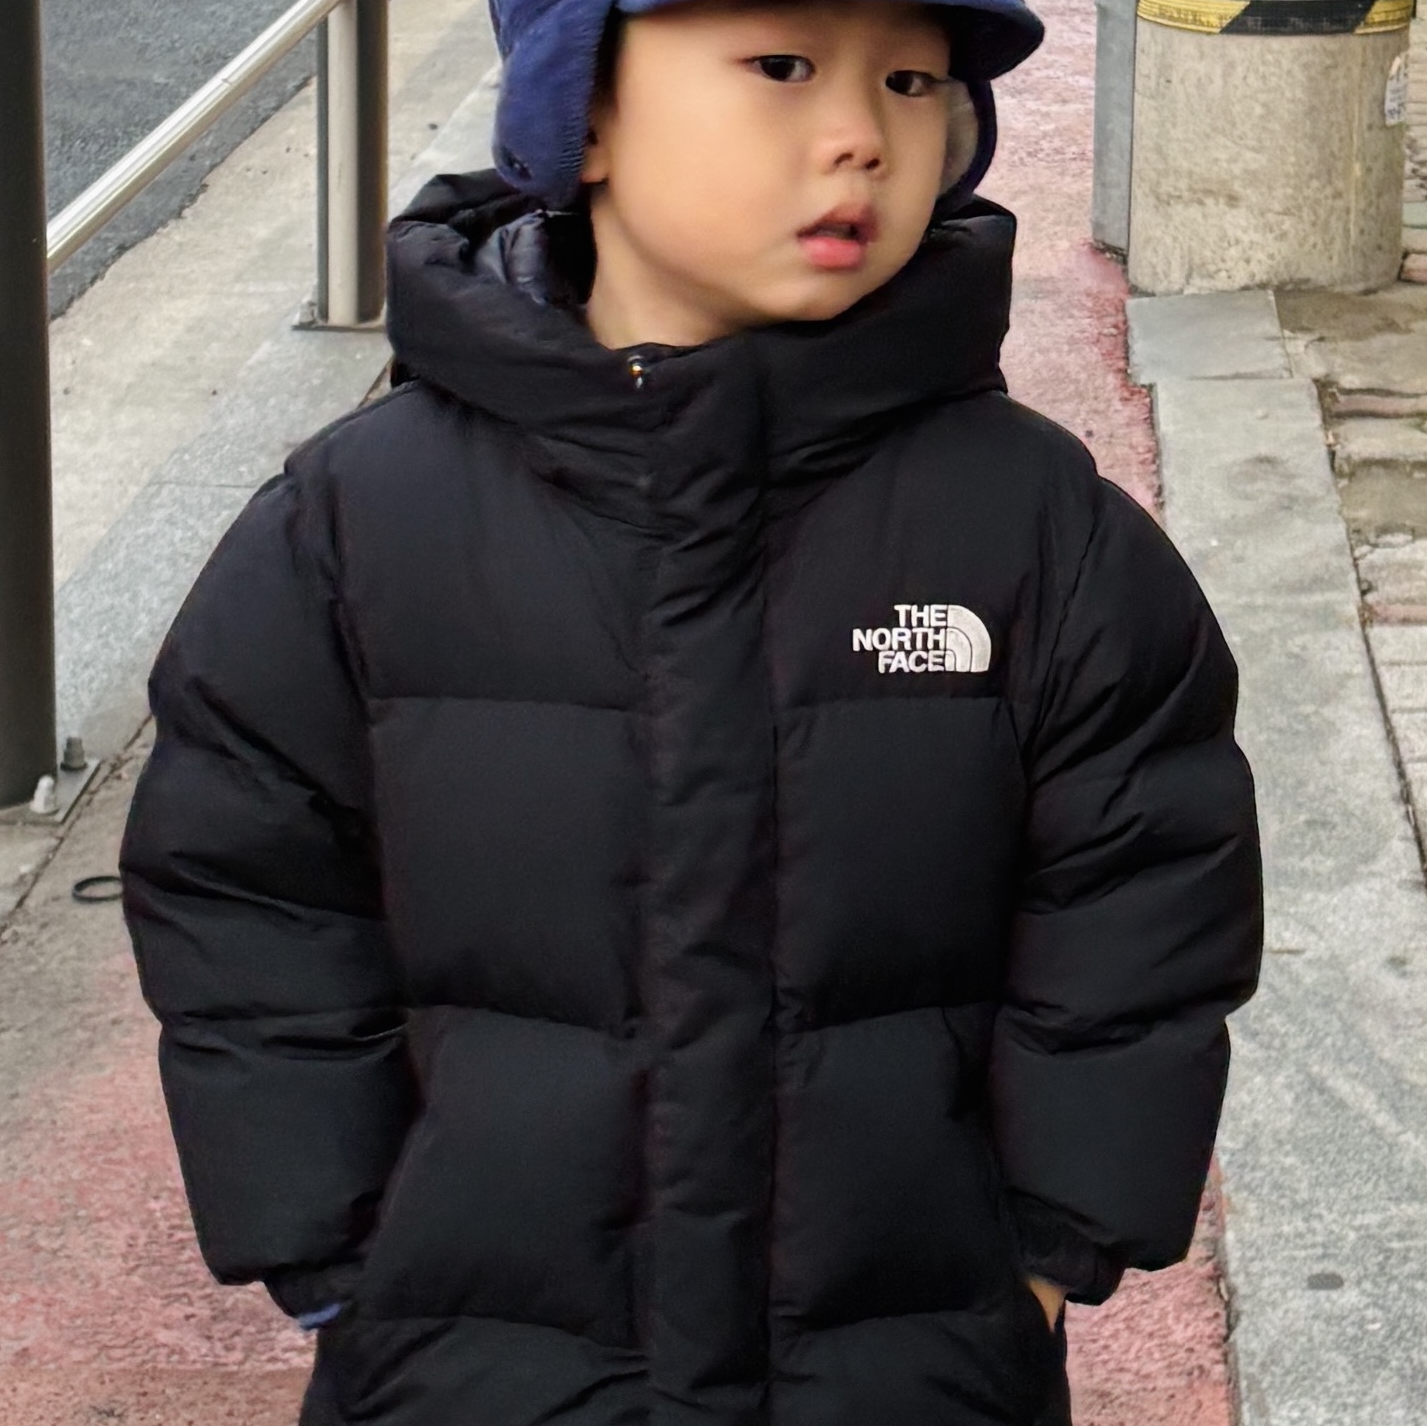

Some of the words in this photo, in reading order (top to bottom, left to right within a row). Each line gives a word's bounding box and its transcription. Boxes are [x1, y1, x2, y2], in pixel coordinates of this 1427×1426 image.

[893, 604, 948, 628] THE
[852, 627, 946, 652] NORTH
[878, 650, 945, 674] FACE
